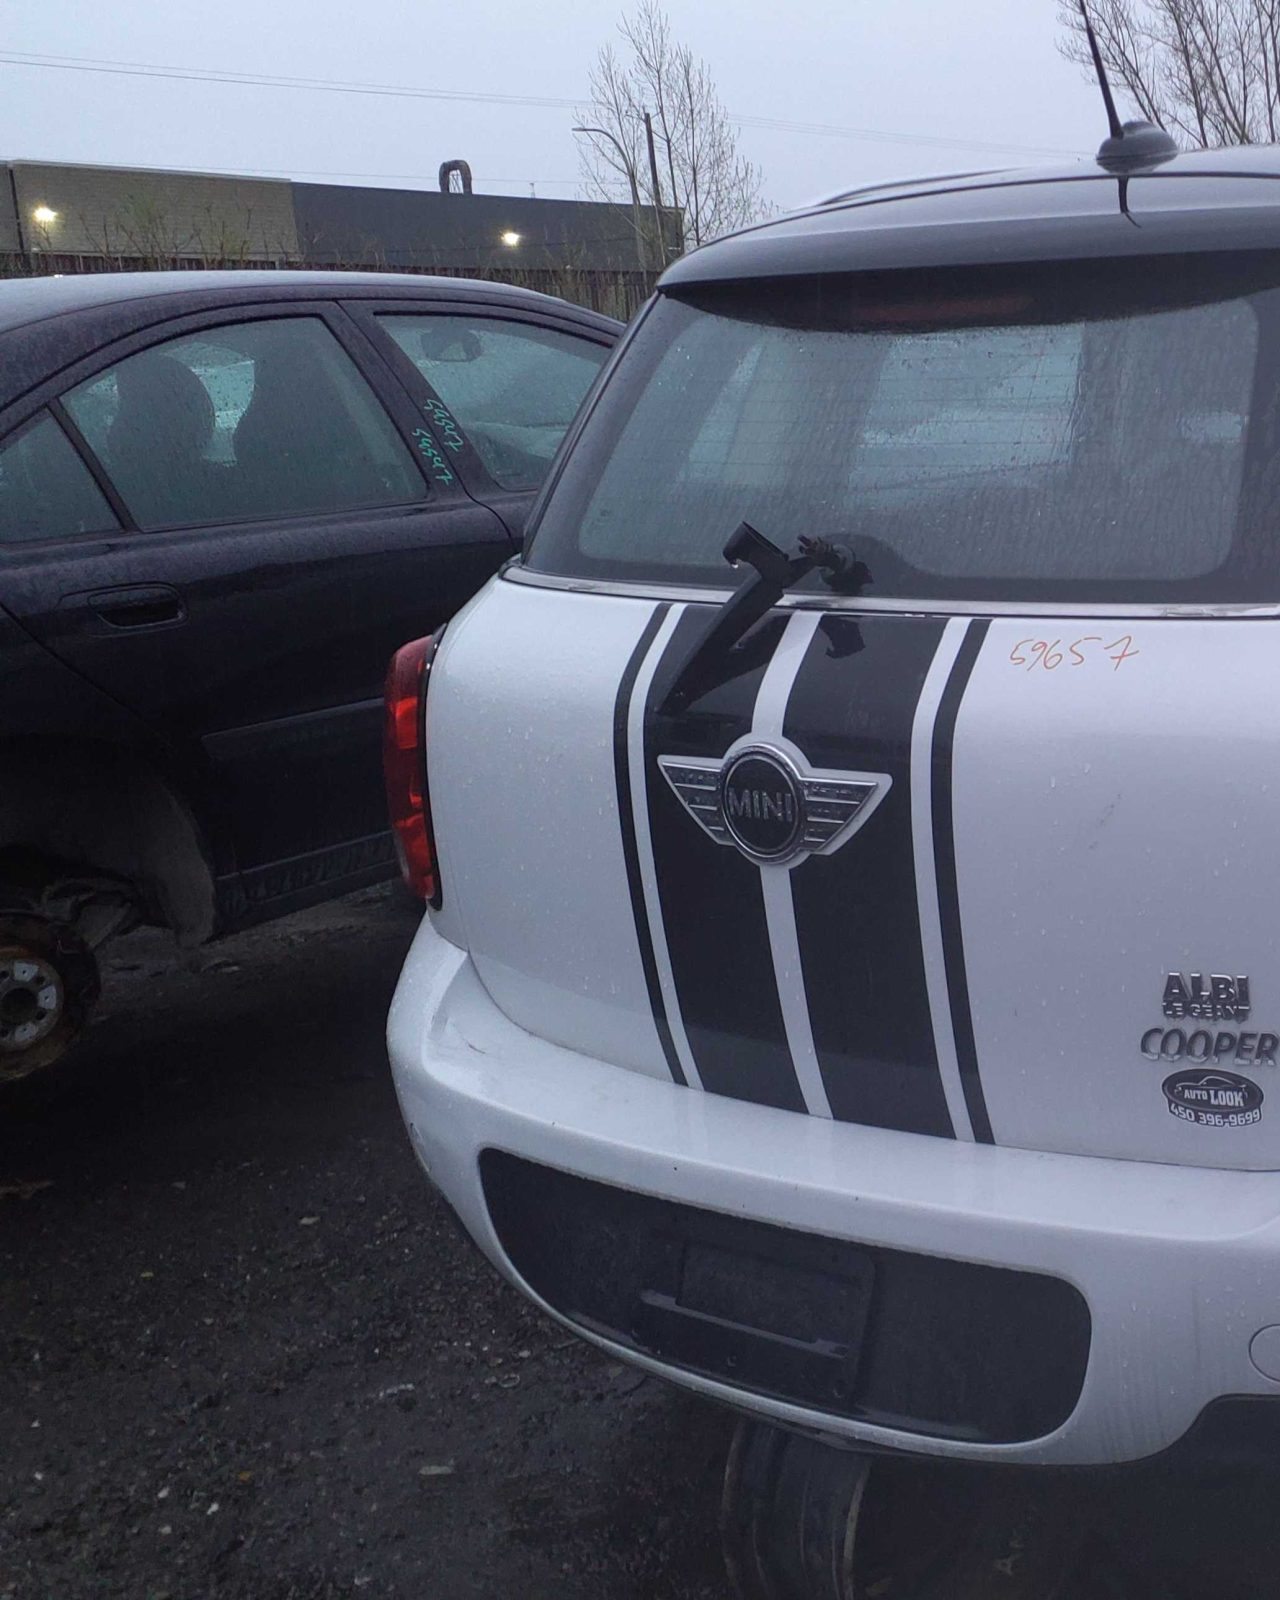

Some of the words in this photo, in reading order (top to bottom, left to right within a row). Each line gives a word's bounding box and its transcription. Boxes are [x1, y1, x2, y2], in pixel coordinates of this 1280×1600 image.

[1009, 635, 1140, 672] 59657
[728, 787, 793, 822] MINI
[1162, 972, 1250, 1003] ALBI
[1140, 1027, 1280, 1066] COOPER
[1171, 1102, 1196, 1122] 450
[1199, 1107, 1261, 1127] 396-9699
[1184, 1089, 1208, 1101] AUTO
[1209, 1089, 1245, 1107] LOOK
